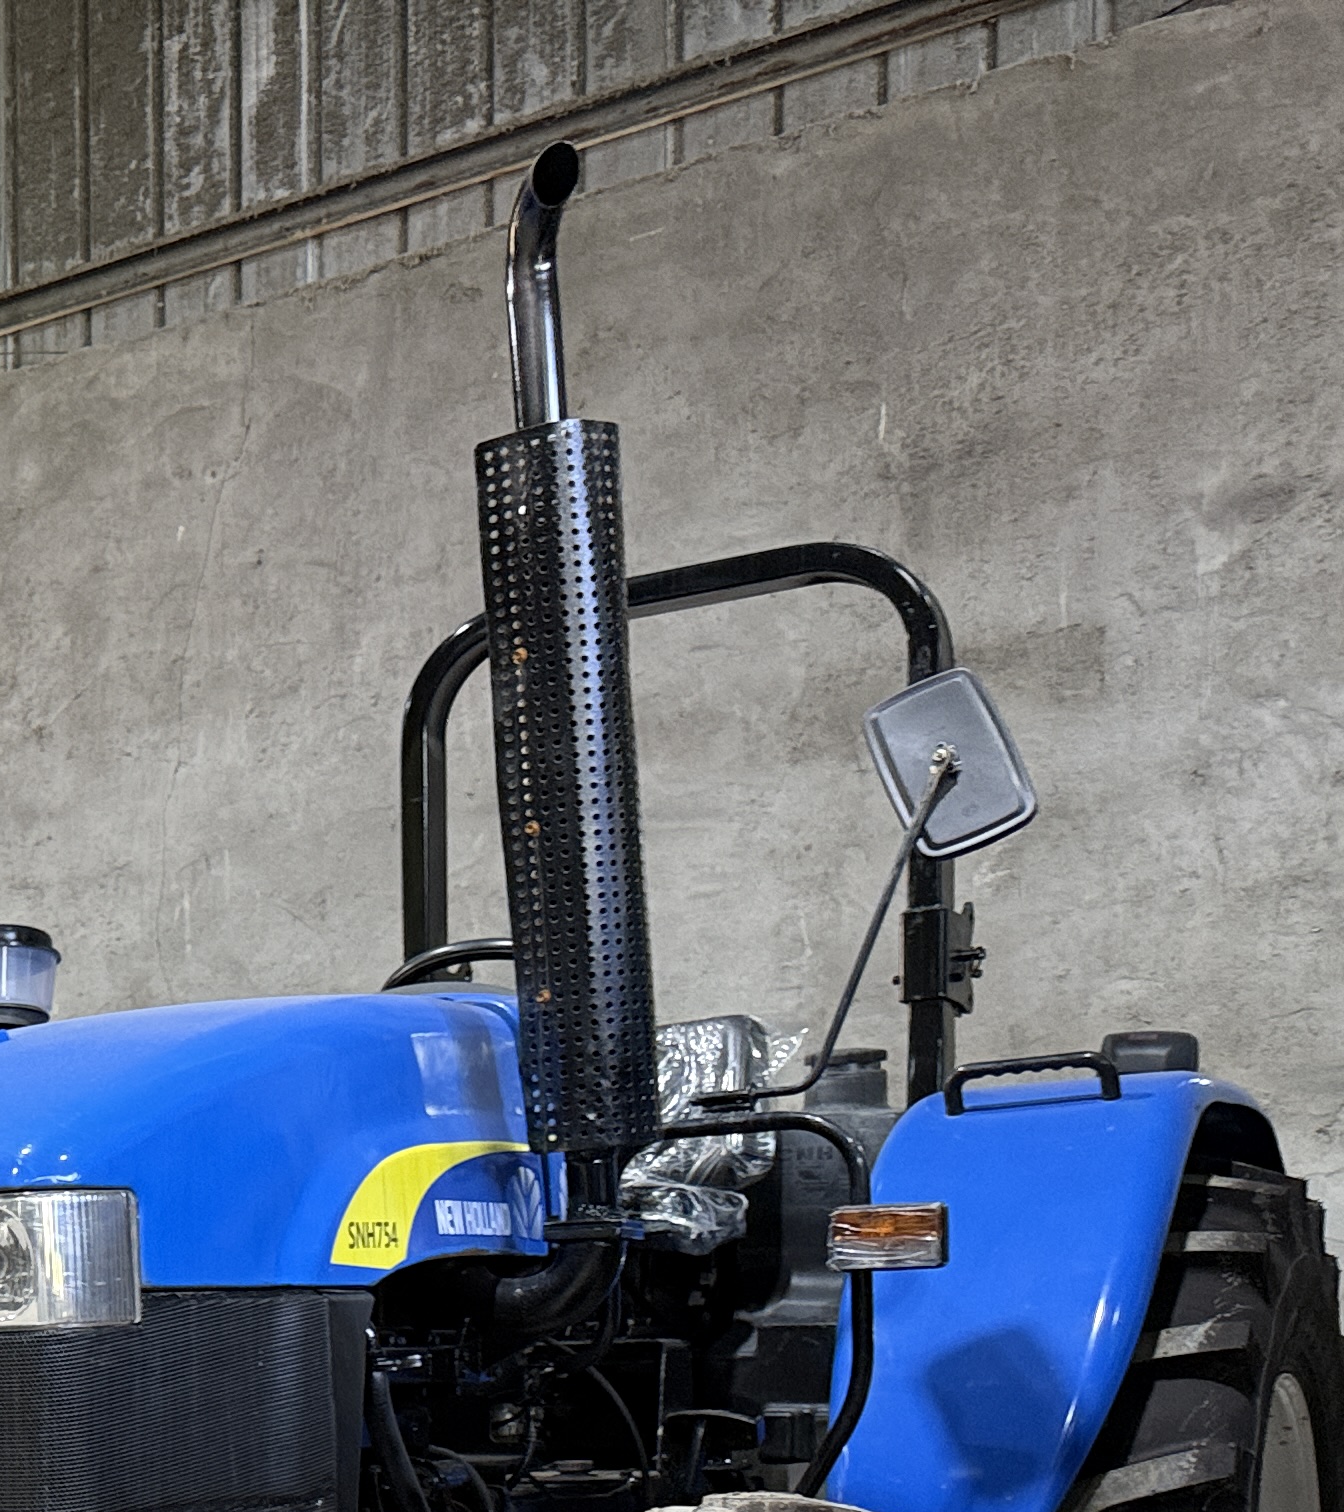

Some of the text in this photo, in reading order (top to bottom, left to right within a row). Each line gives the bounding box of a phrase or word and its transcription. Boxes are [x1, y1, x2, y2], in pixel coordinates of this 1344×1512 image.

[434, 1200, 511, 1236] NEW HOLLAND
[348, 1221, 399, 1249] SNH754
